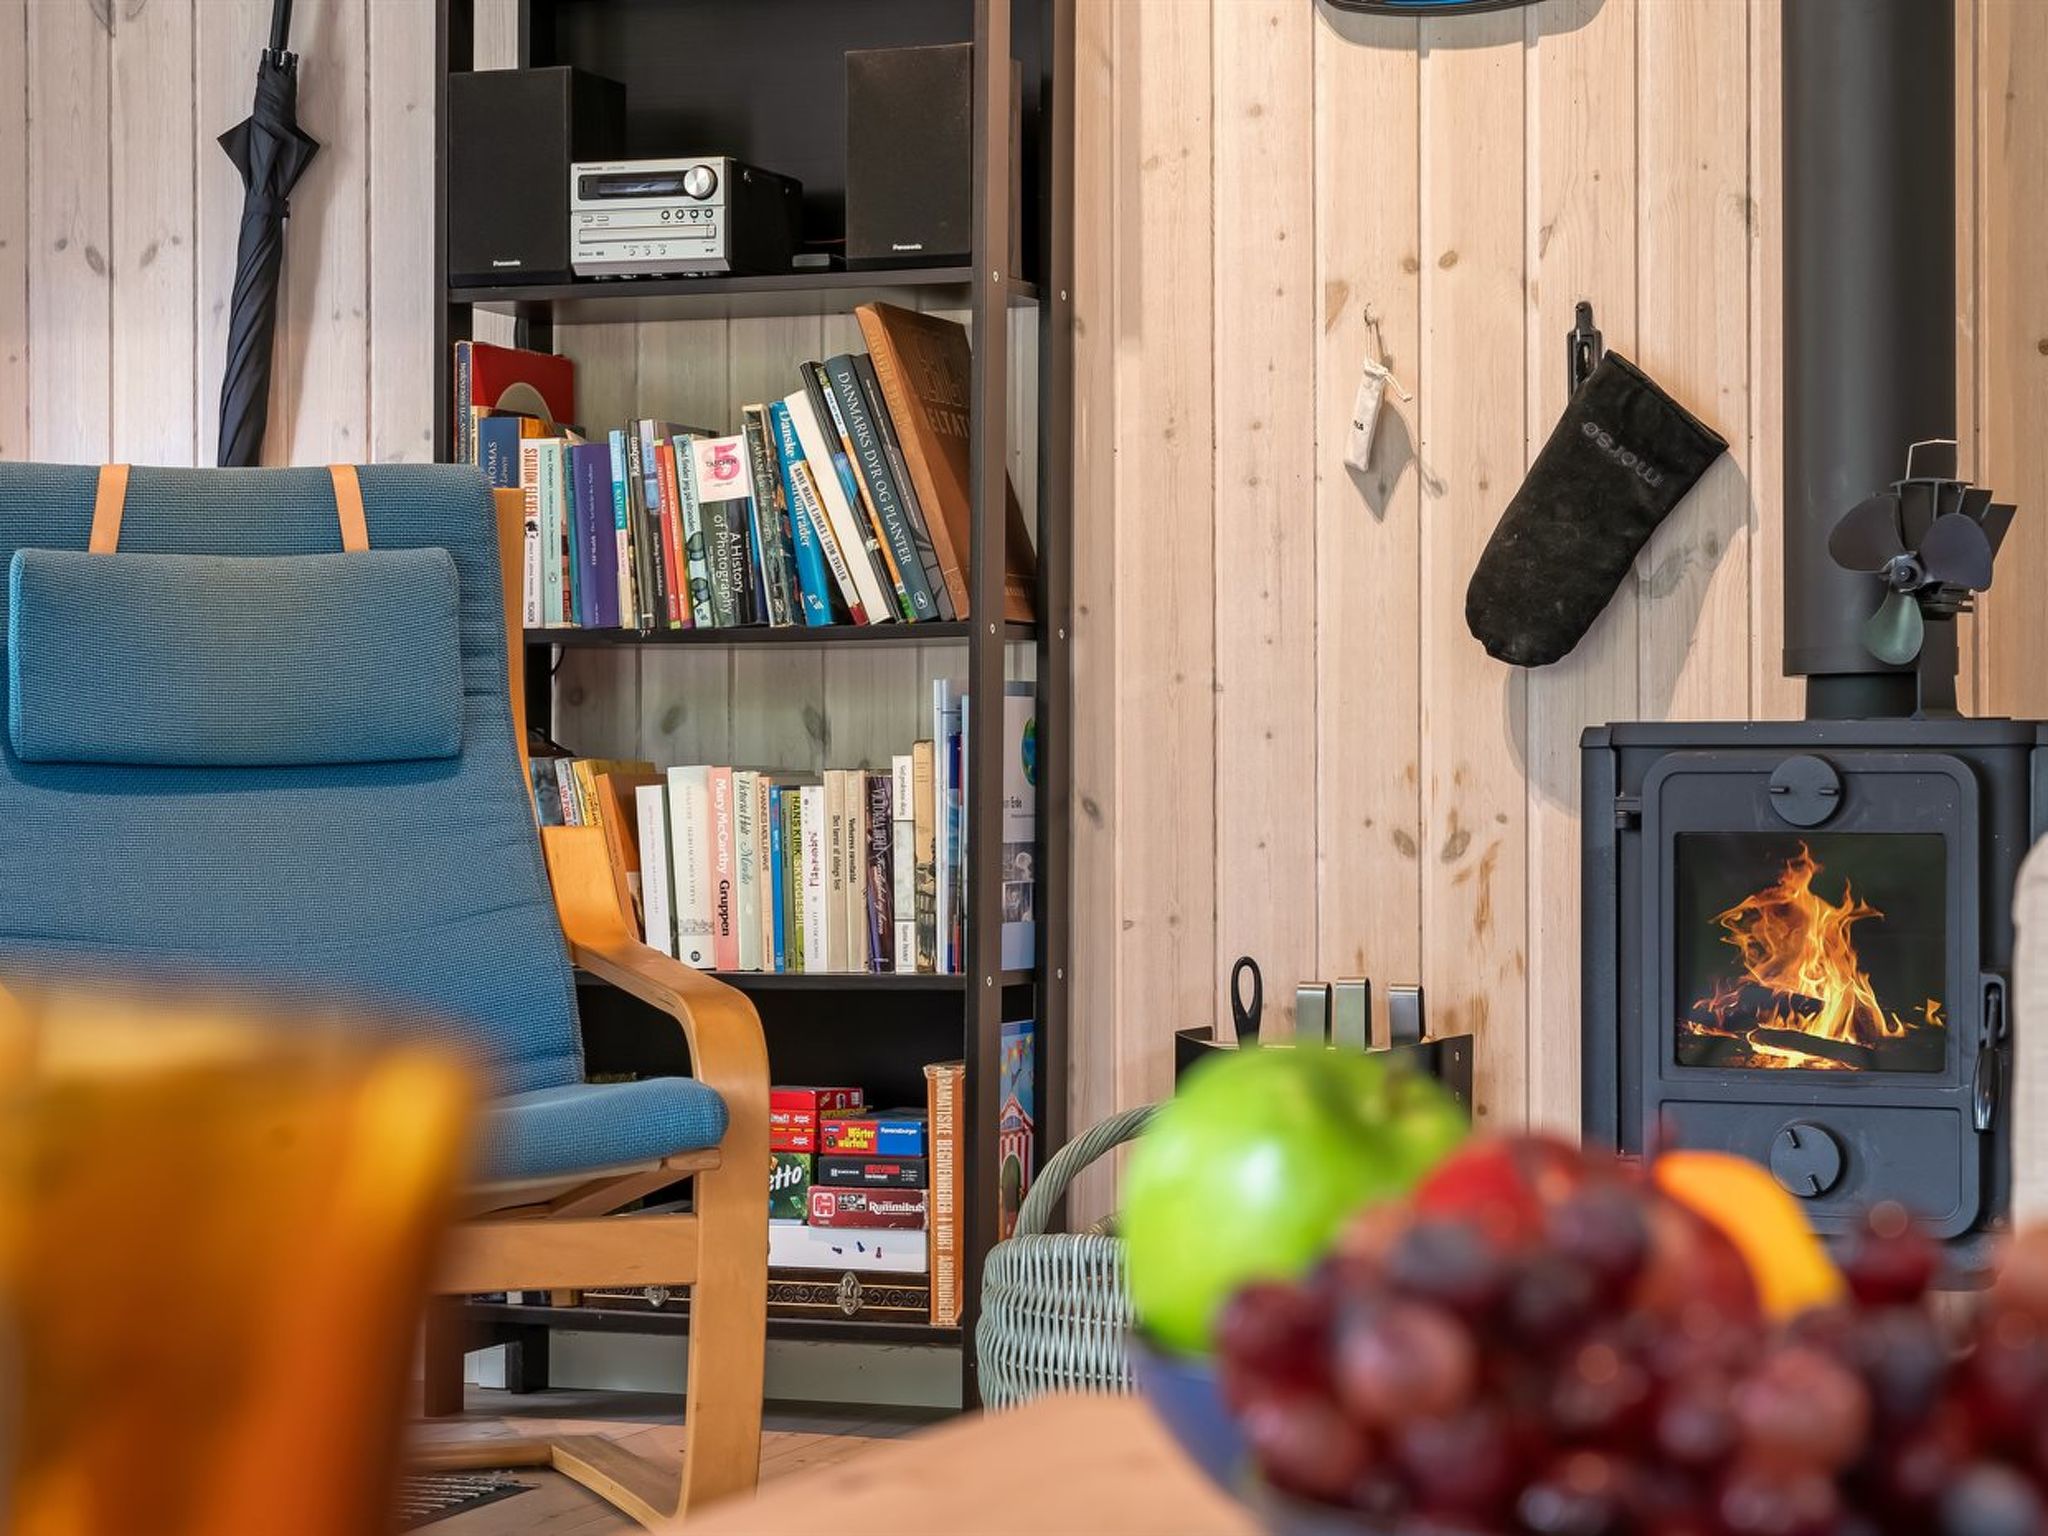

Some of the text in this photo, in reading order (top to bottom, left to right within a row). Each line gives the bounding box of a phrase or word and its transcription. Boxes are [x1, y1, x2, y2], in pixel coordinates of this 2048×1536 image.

[835, 370, 873, 448] DANMARKS
[778, 409, 795, 457] Danske
[862, 448, 884, 479] DYR
[524, 448, 540, 518] STATION ELEVEN
[873, 478, 892, 503] OG
[882, 503, 914, 564] PLANTER
[713, 514, 734, 614] of Photography
[729, 531, 744, 593] A History
[737, 779, 750, 814] Victoria
[758, 781, 767, 823] JOHANNES
[791, 796, 801, 826] HANS
[739, 813, 752, 836] Holt
[872, 787, 888, 852] VICTORIA HOLT
[714, 777, 730, 936] Mary McCarthy Gruppen
[792, 828, 802, 856] KIRK
[936, 1067, 953, 1136] DRAMATISKE
[838, 1136, 868, 1149] würfeln
[847, 1127, 875, 1139] Wörter
[880, 1127, 917, 1135] Ravensburger
[936, 1139, 953, 1214] BEGIVENHEDER
[869, 1201, 925, 1215] Rummikub
[937, 1224, 953, 1251] VORT
